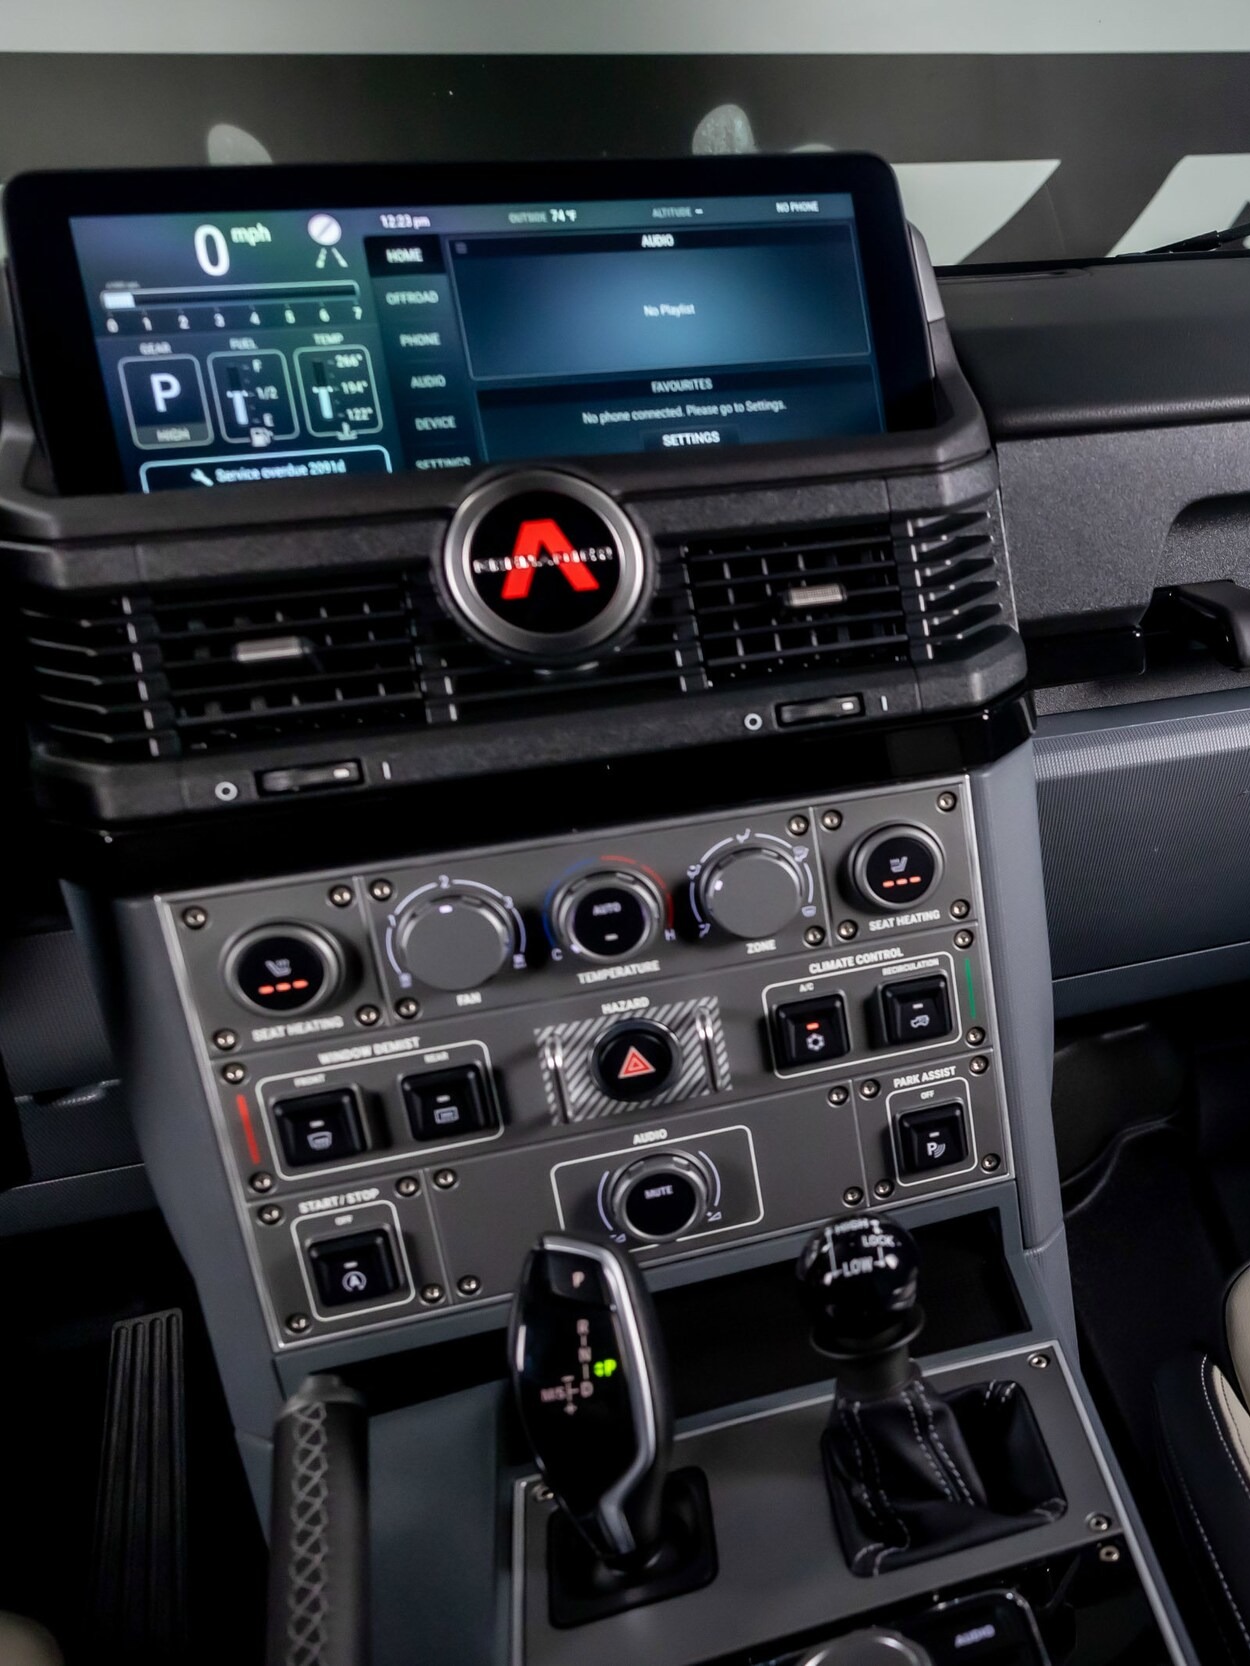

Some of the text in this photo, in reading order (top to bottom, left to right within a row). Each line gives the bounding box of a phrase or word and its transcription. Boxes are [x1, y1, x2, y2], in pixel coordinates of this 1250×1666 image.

[652, 207, 692, 218] ALTITUDE
[776, 201, 819, 213] NO PHONE
[641, 234, 675, 248] AUDIO
[194, 222, 272, 276] 0 mph
[386, 248, 424, 264] HOME
[386, 290, 439, 305] OFFROAD
[643, 303, 696, 317] No Playlist
[313, 332, 344, 345] TEMP
[400, 332, 441, 347] PHONE
[411, 374, 446, 389] AUDIO
[651, 378, 713, 393] FAVOURITES
[150, 372, 181, 413] P
[582, 399, 787, 425] No phone connected. Please go to Settings.
[415, 416, 456, 431] DEVICE
[662, 431, 720, 447] SETTINGS
[215, 468, 260, 482] Service
[261, 463, 308, 479] overdue
[593, 902, 621, 916] AUTO
[869, 909, 941, 932] SEAT HEATING
[664, 928, 676, 941] H
[746, 939, 776, 954] ZONE
[551, 948, 563, 961] C
[809, 947, 904, 975] CLIMATE CONTROL
[577, 960, 660, 984] TEMPERATURE
[881, 958, 940, 976] RECIRCULATION
[799, 982, 815, 993] A/C
[456, 992, 482, 1006] FAN
[601, 996, 650, 1015] HAZARD
[252, 1015, 344, 1042] SEAT HEATING
[317, 1045, 373, 1065] WINDOW
[893, 1066, 956, 1088] PARK ASSIST
[920, 1090, 935, 1099] OFF
[633, 1128, 668, 1145] AUDIO
[644, 1185, 674, 1199] MUTE
[861, 1234, 896, 1248] LOCK
[842, 1256, 873, 1277] LOW
